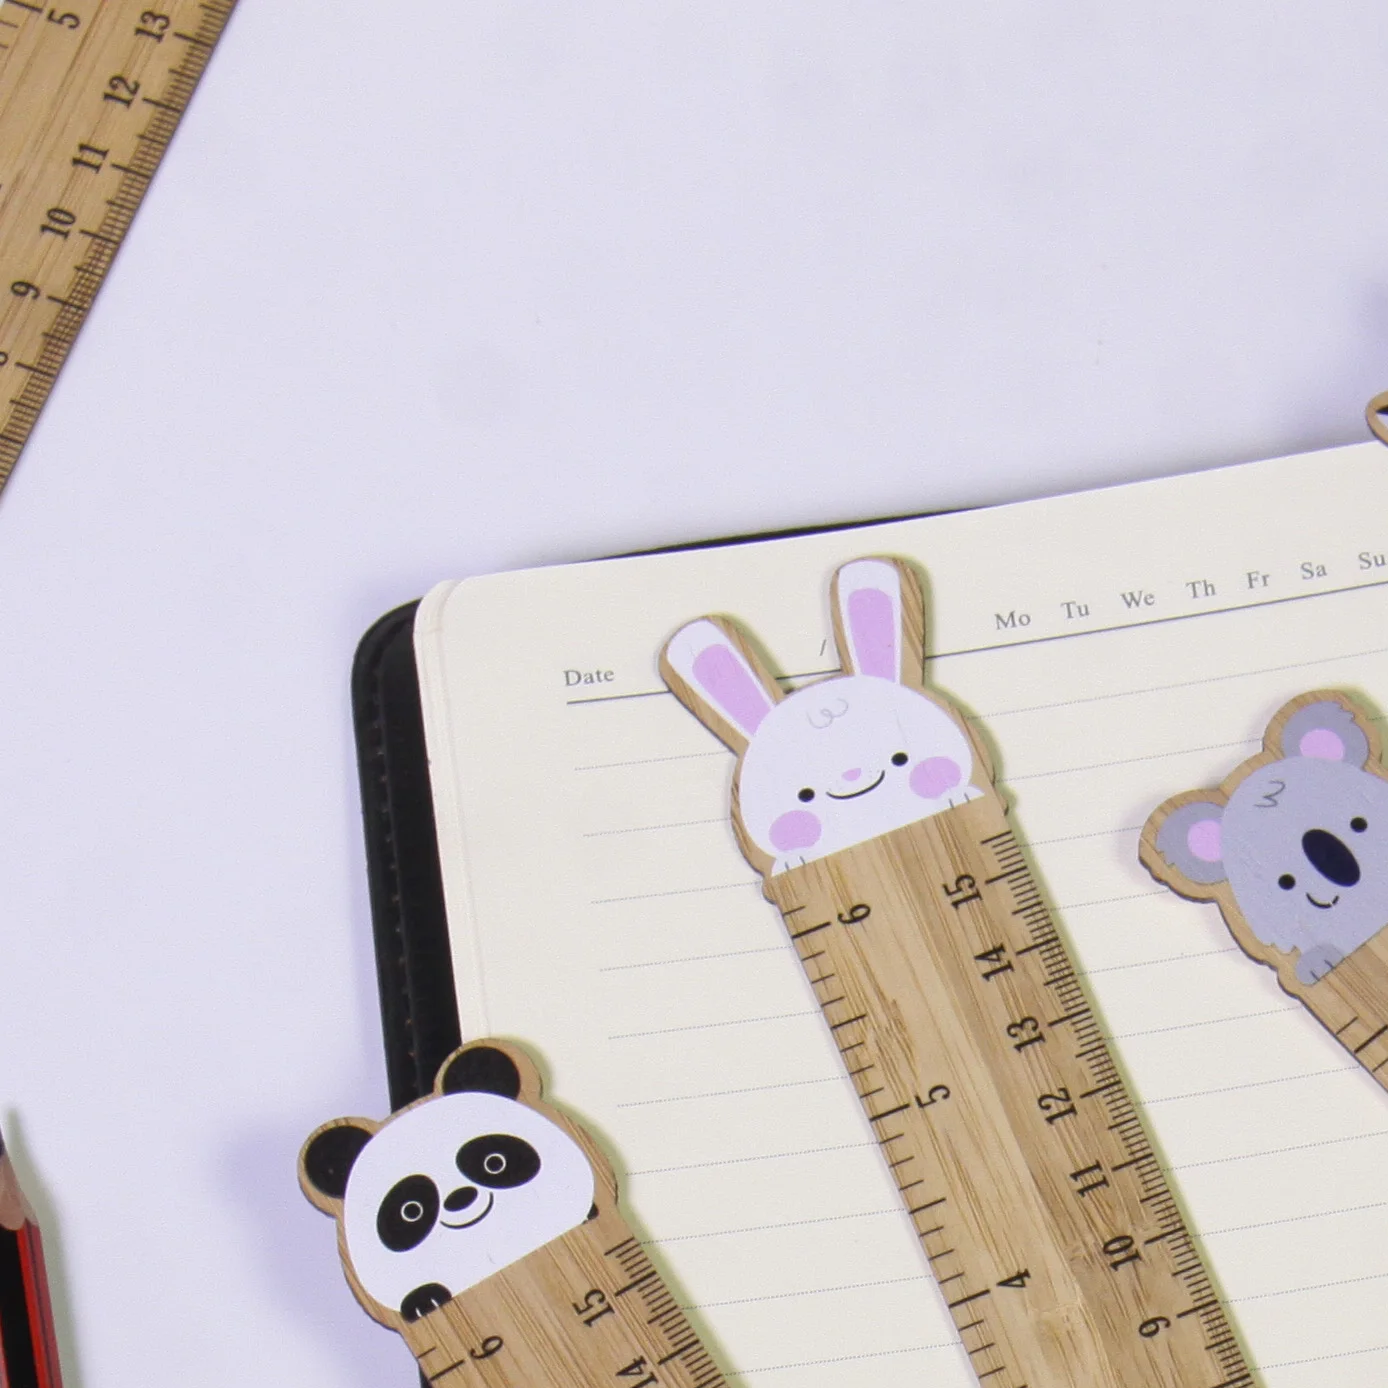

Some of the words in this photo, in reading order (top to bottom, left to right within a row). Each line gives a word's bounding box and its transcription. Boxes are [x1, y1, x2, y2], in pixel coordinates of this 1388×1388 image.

[47, 7, 82, 30] 5
[11, 279, 41, 301] 9
[40, 207, 77, 240] 10
[71, 141, 110, 174] 11
[103, 74, 140, 109] 12
[134, 10, 171, 43] 13
[994, 611, 1032, 630] Mo
[1061, 601, 1090, 620] Tu
[1120, 590, 1156, 609] We
[1185, 579, 1217, 599] Th
[1246, 571, 1271, 590] Fr
[1300, 562, 1328, 580] Sa
[1358, 552, 1387, 570] Su
[564, 667, 615, 687] Date
[942, 873, 983, 911] 15
[837, 904, 871, 929] 6
[974, 942, 1015, 982] 14
[1006, 1014, 1046, 1053] 13
[914, 1085, 950, 1111] 5
[1037, 1084, 1078, 1125] 12
[1070, 1158, 1110, 1197] 11
[1102, 1234, 1144, 1272] 10
[996, 1268, 1031, 1288] 4
[572, 1285, 615, 1327] 15
[1138, 1316, 1171, 1338] 9
[470, 1335, 504, 1360] 6
